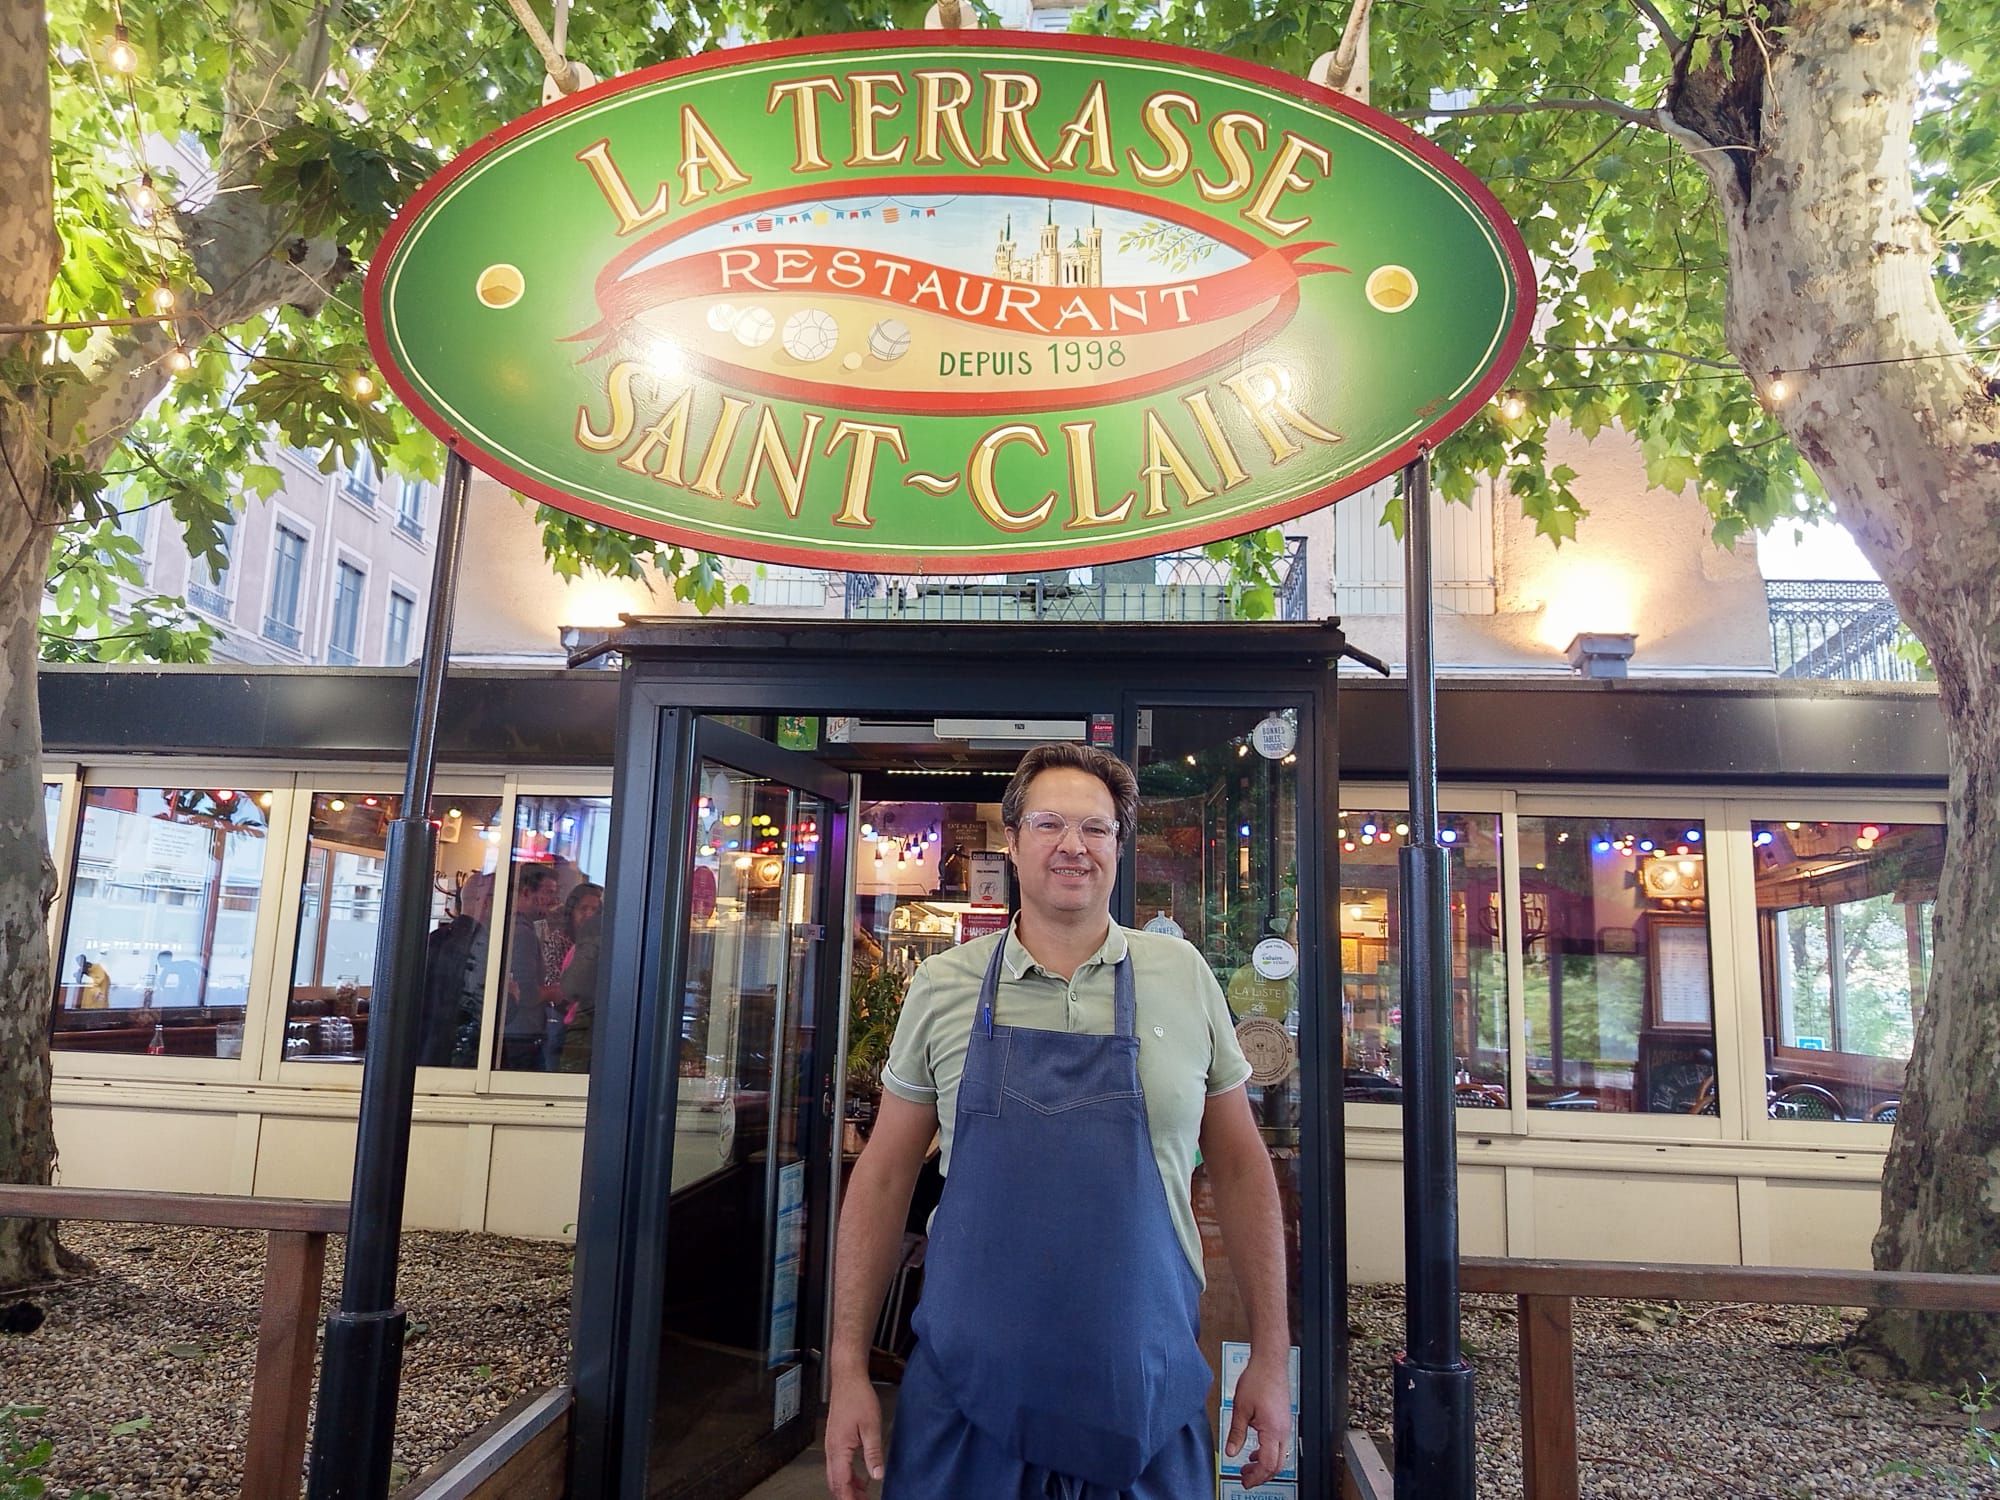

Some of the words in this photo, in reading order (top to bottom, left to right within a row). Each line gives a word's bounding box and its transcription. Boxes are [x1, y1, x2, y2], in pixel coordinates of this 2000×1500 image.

[576, 103, 752, 237] LA
[766, 68, 1333, 238] TERRASSE
[717, 247, 1200, 334] RESTAURANT
[939, 350, 1033, 378] DEPUIS
[1047, 339, 1127, 376] 1998
[1234, 987, 1249, 996] LA
